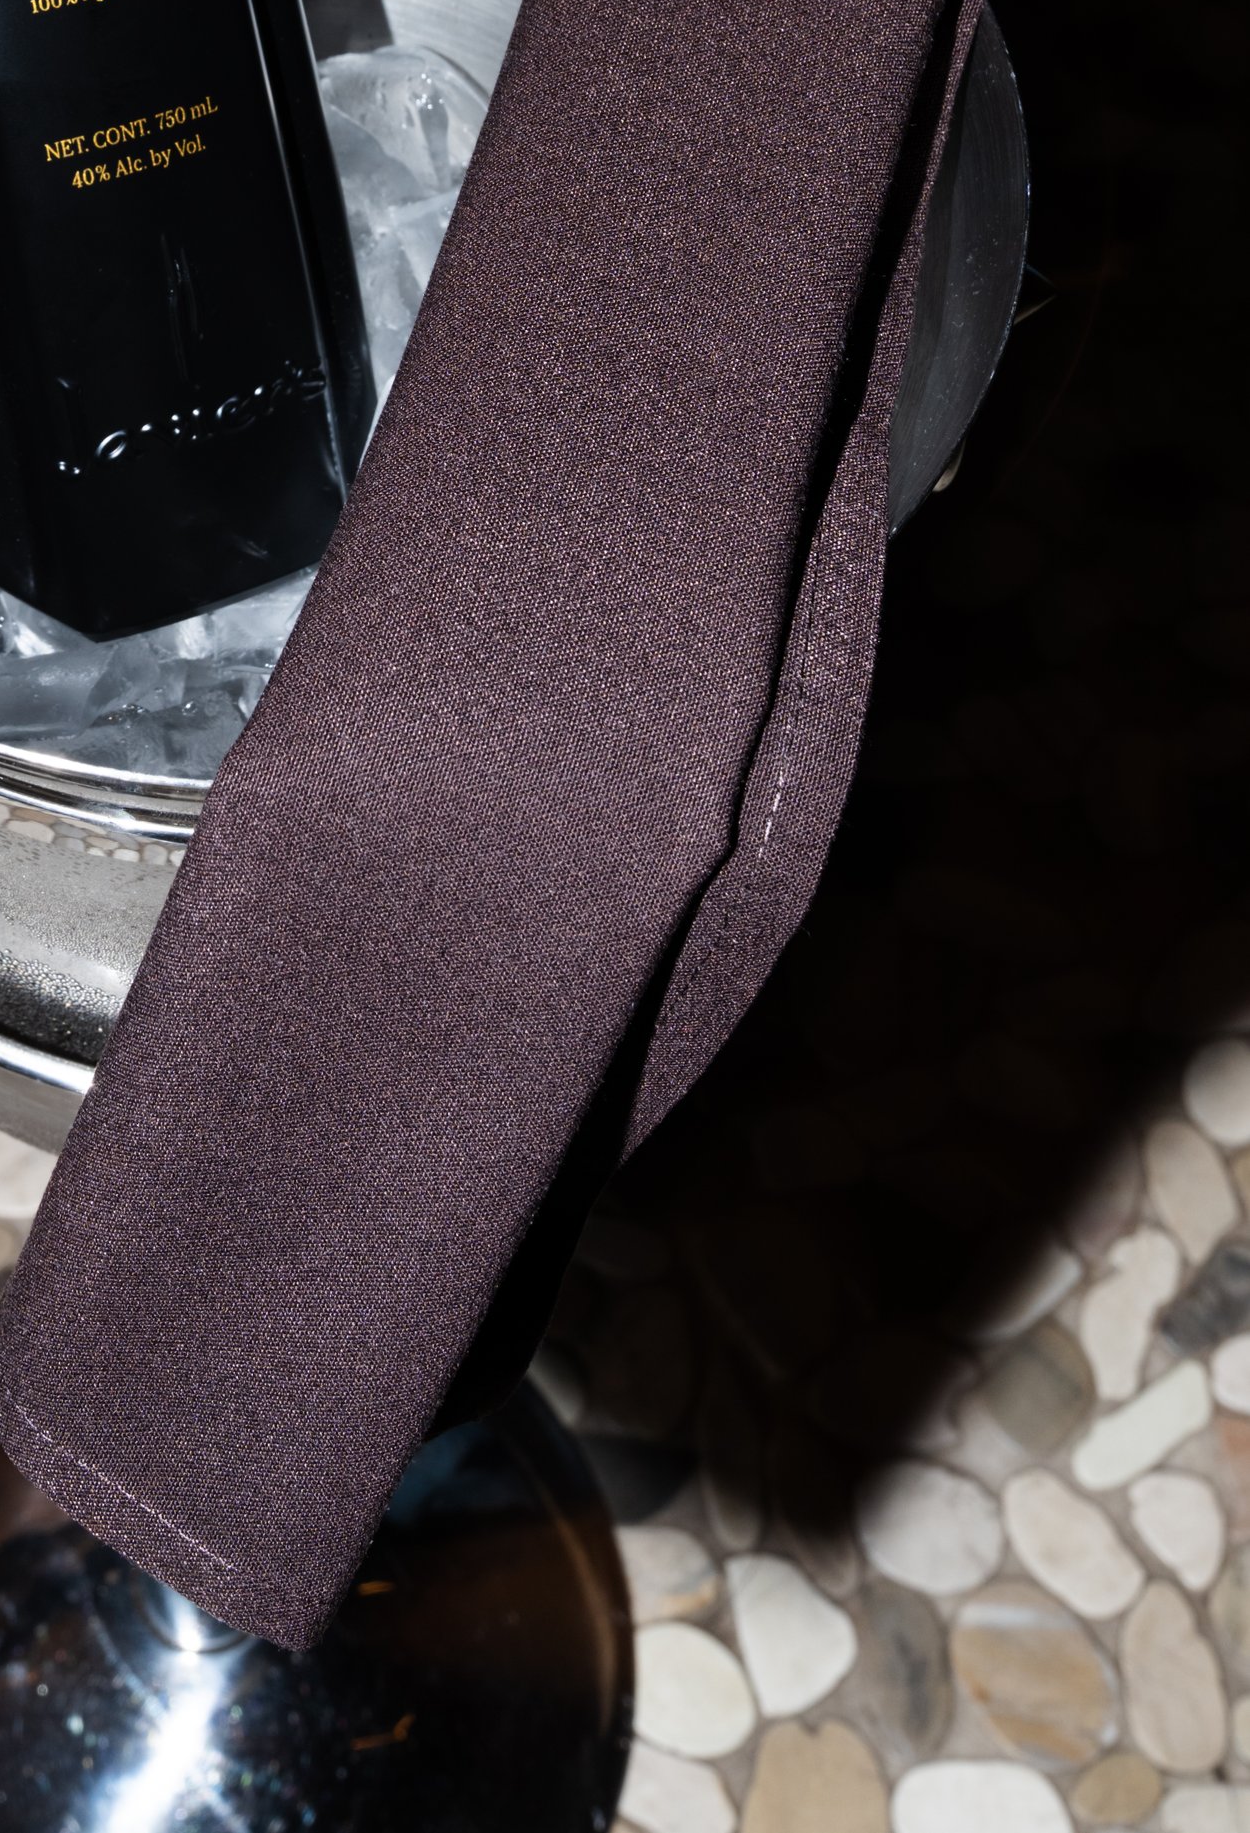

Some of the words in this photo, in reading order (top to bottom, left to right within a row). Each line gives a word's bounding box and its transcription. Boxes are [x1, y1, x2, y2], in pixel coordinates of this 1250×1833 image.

[44, 135, 90, 161] NET.
[92, 118, 151, 149] CONT.
[155, 106, 187, 130] 750
[190, 96, 219, 120] mL
[71, 165, 111, 189] 40%
[115, 152, 148, 177] Alc.
[150, 146, 172, 168] by
[174, 134, 206, 157] Vol.
